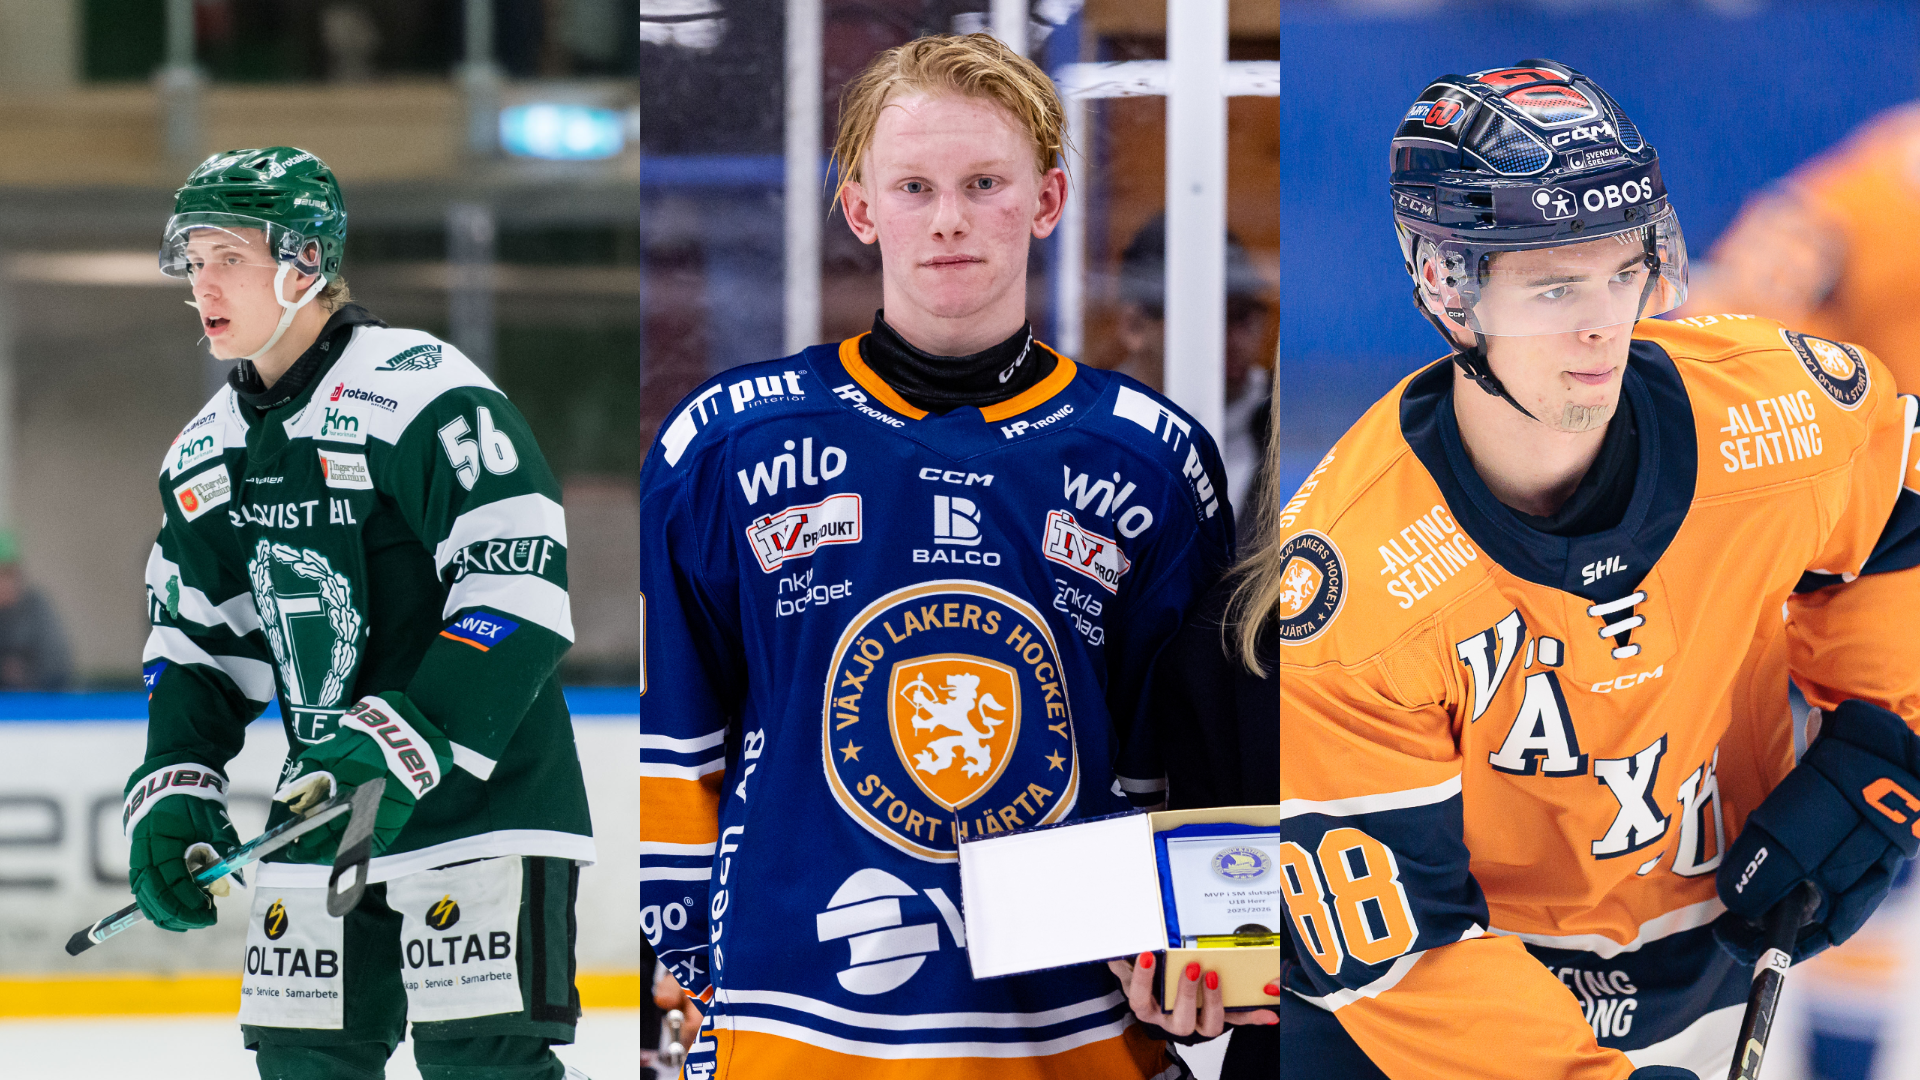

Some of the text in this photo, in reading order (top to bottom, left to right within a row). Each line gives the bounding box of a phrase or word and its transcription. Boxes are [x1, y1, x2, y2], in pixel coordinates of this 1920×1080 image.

[1424, 100, 1461, 126] GO
[1551, 121, 1618, 147] CCM
[1585, 147, 1620, 160] SVENSKA
[1587, 158, 1607, 167] SPEL
[1398, 194, 1434, 217] CCM
[1582, 176, 1653, 212] OBOS
[342, 388, 398, 410] rotakorn
[1720, 389, 1816, 437] ALFING
[437, 406, 519, 491] 56
[1719, 422, 1823, 473] SEATING
[327, 459, 366, 473] Tingsryds
[330, 469, 368, 482] kommun
[737, 437, 848, 505] wilo
[918, 467, 994, 486] CCM
[1063, 464, 1154, 539] wilo
[1378, 504, 1457, 576] ALFING
[453, 538, 554, 580] SKRUF
[912, 549, 1001, 566] BALCO
[1094, 561, 1119, 585] PROD
[1386, 532, 1478, 610] SEATING
[1581, 555, 1628, 586] SHL
[1296, 537, 1330, 560] LAKERS
[1324, 559, 1339, 611] HOCKEY
[833, 602, 1068, 741] VÄXJÖ LAKERS HOCKEY
[1590, 664, 1664, 694] CCM
[345, 701, 434, 795] BAUER
[857, 774, 942, 842] STORT
[1735, 846, 1769, 894] CCM
[1227, 906, 1272, 914] 2025/2026
[1280, 827, 1420, 976] 88
[244, 945, 339, 979] OLTAB
[256, 986, 280, 997] Service
[285, 988, 338, 999] Samarbete
[425, 978, 453, 989] Service
[461, 971, 512, 985] Samarbete
[1555, 967, 1639, 997] FING
